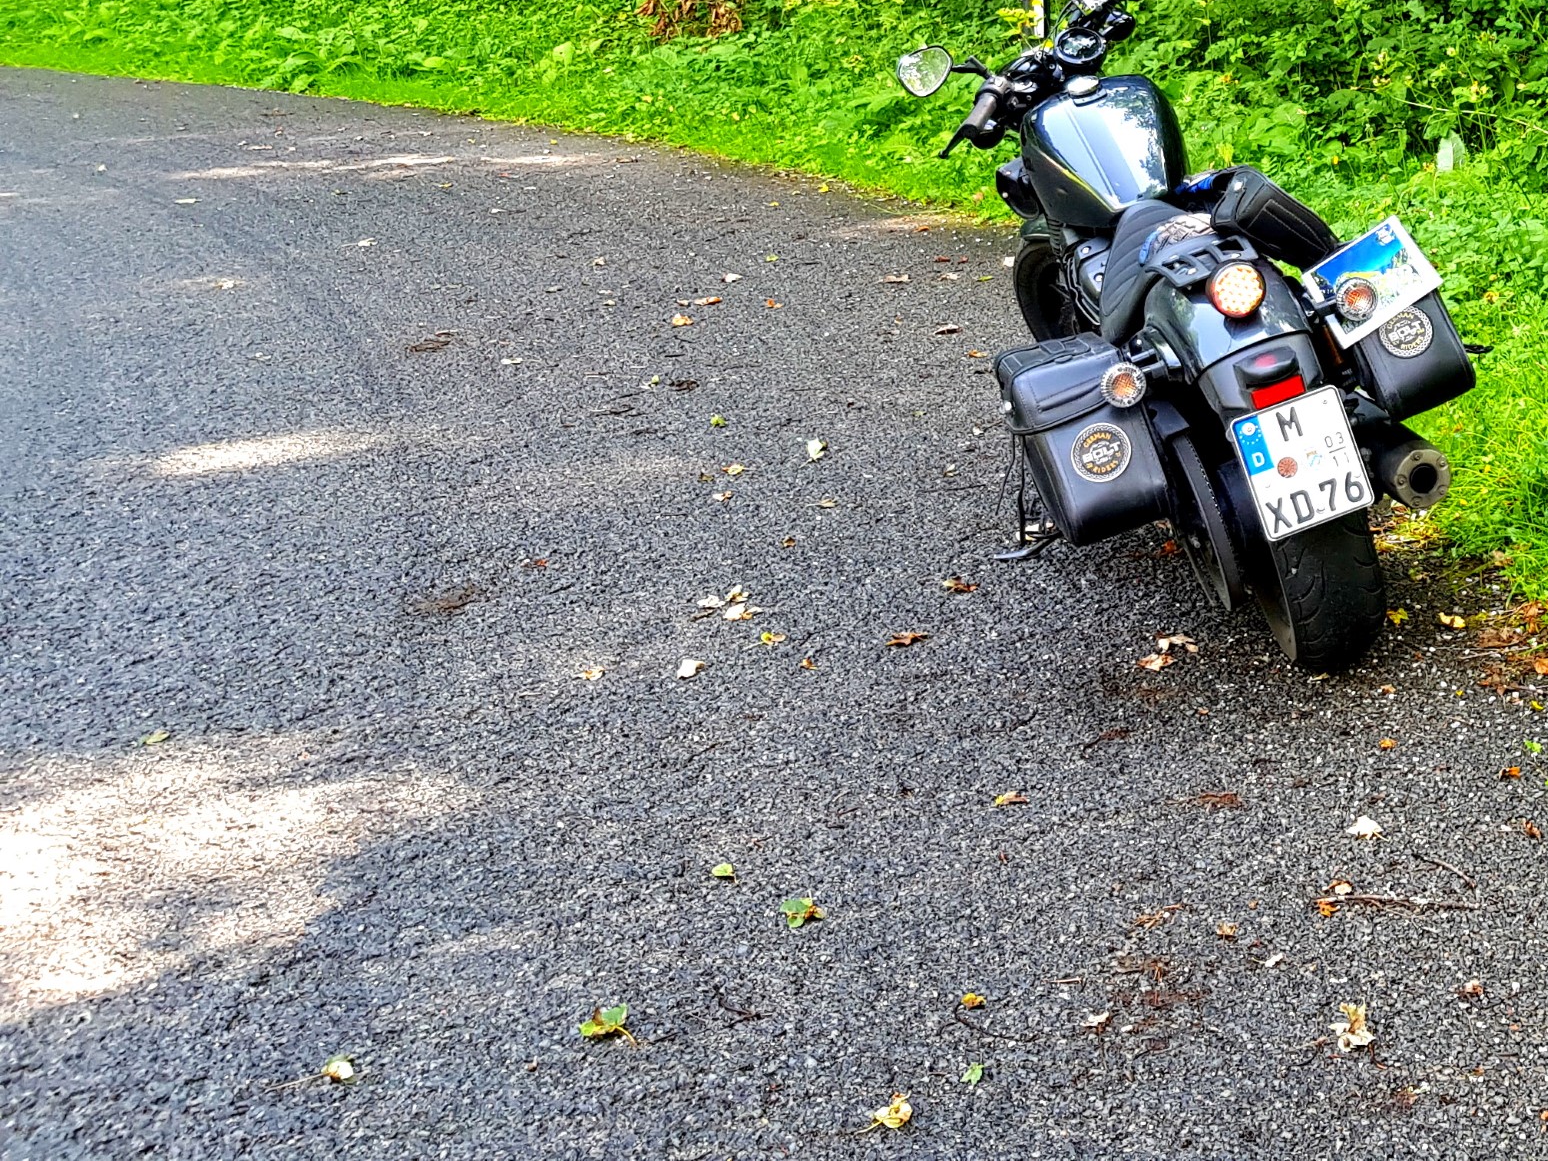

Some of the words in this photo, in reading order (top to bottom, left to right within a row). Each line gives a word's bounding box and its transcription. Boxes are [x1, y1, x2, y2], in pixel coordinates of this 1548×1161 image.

[1388, 320, 1421, 342] BOLT
[1275, 406, 1304, 442] M
[1083, 432, 1112, 448] GERMAN
[1082, 441, 1120, 464] BOLT
[1251, 451, 1265, 468] D
[1093, 460, 1119, 474] RIDERS
